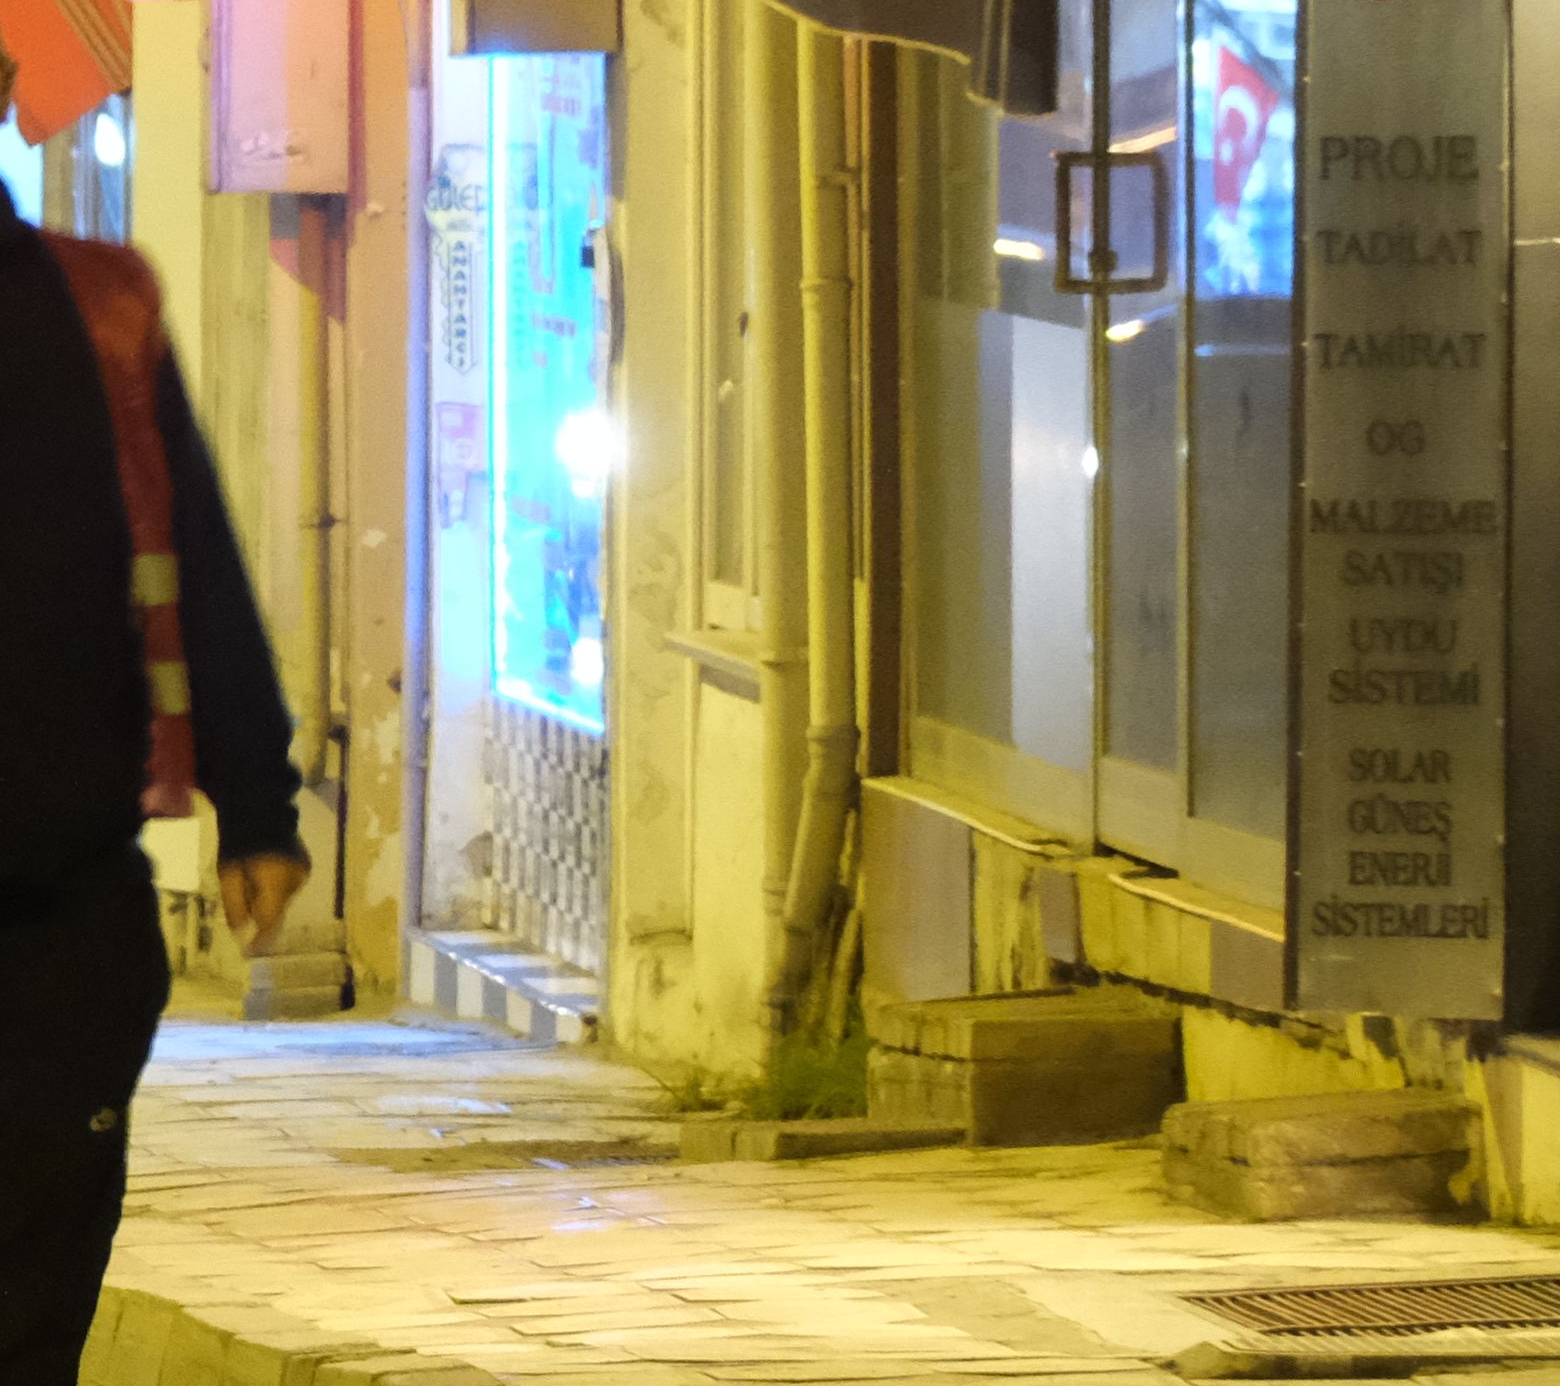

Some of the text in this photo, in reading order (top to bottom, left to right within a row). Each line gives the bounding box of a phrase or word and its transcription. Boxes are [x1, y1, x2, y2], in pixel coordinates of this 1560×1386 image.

[1318, 135, 1481, 182] PROJE
[1315, 220, 1482, 266] TADİLAT
[1314, 325, 1487, 369] TAMİRAT
[1310, 499, 1497, 534] MALZEME
[1343, 550, 1464, 594] SATIŞI
[1350, 619, 1457, 653] UYDU
[1328, 662, 1481, 705] SİSTEMİ
[1348, 749, 1452, 784] SOLAR
[1347, 793, 1453, 844] GÜNEŞ
[1310, 893, 1490, 940] SİSTEMLERİ
